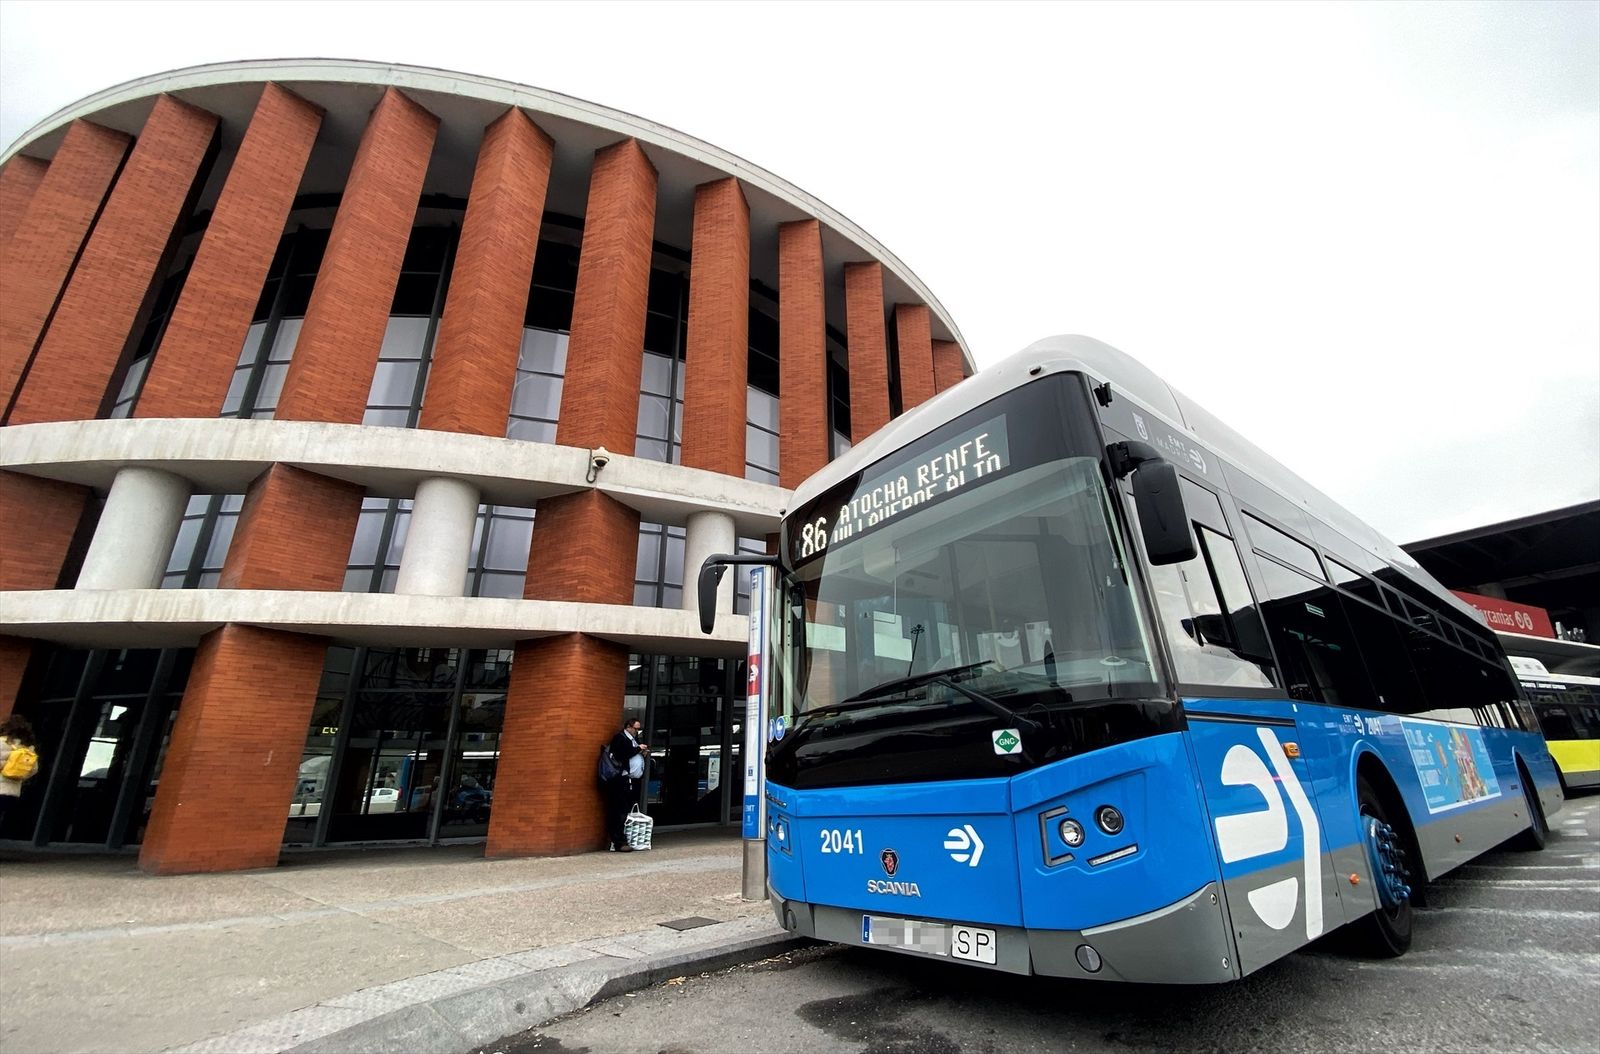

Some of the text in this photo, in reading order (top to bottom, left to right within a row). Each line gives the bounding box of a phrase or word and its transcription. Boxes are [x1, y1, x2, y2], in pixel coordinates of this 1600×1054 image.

[839, 433, 990, 524] ATOCHA RENFE
[801, 516, 828, 558] 86
[998, 737, 1016, 746] GNC
[820, 829, 864, 855] 2041
[867, 879, 922, 898] SCANIA
[957, 930, 990, 957] SP
